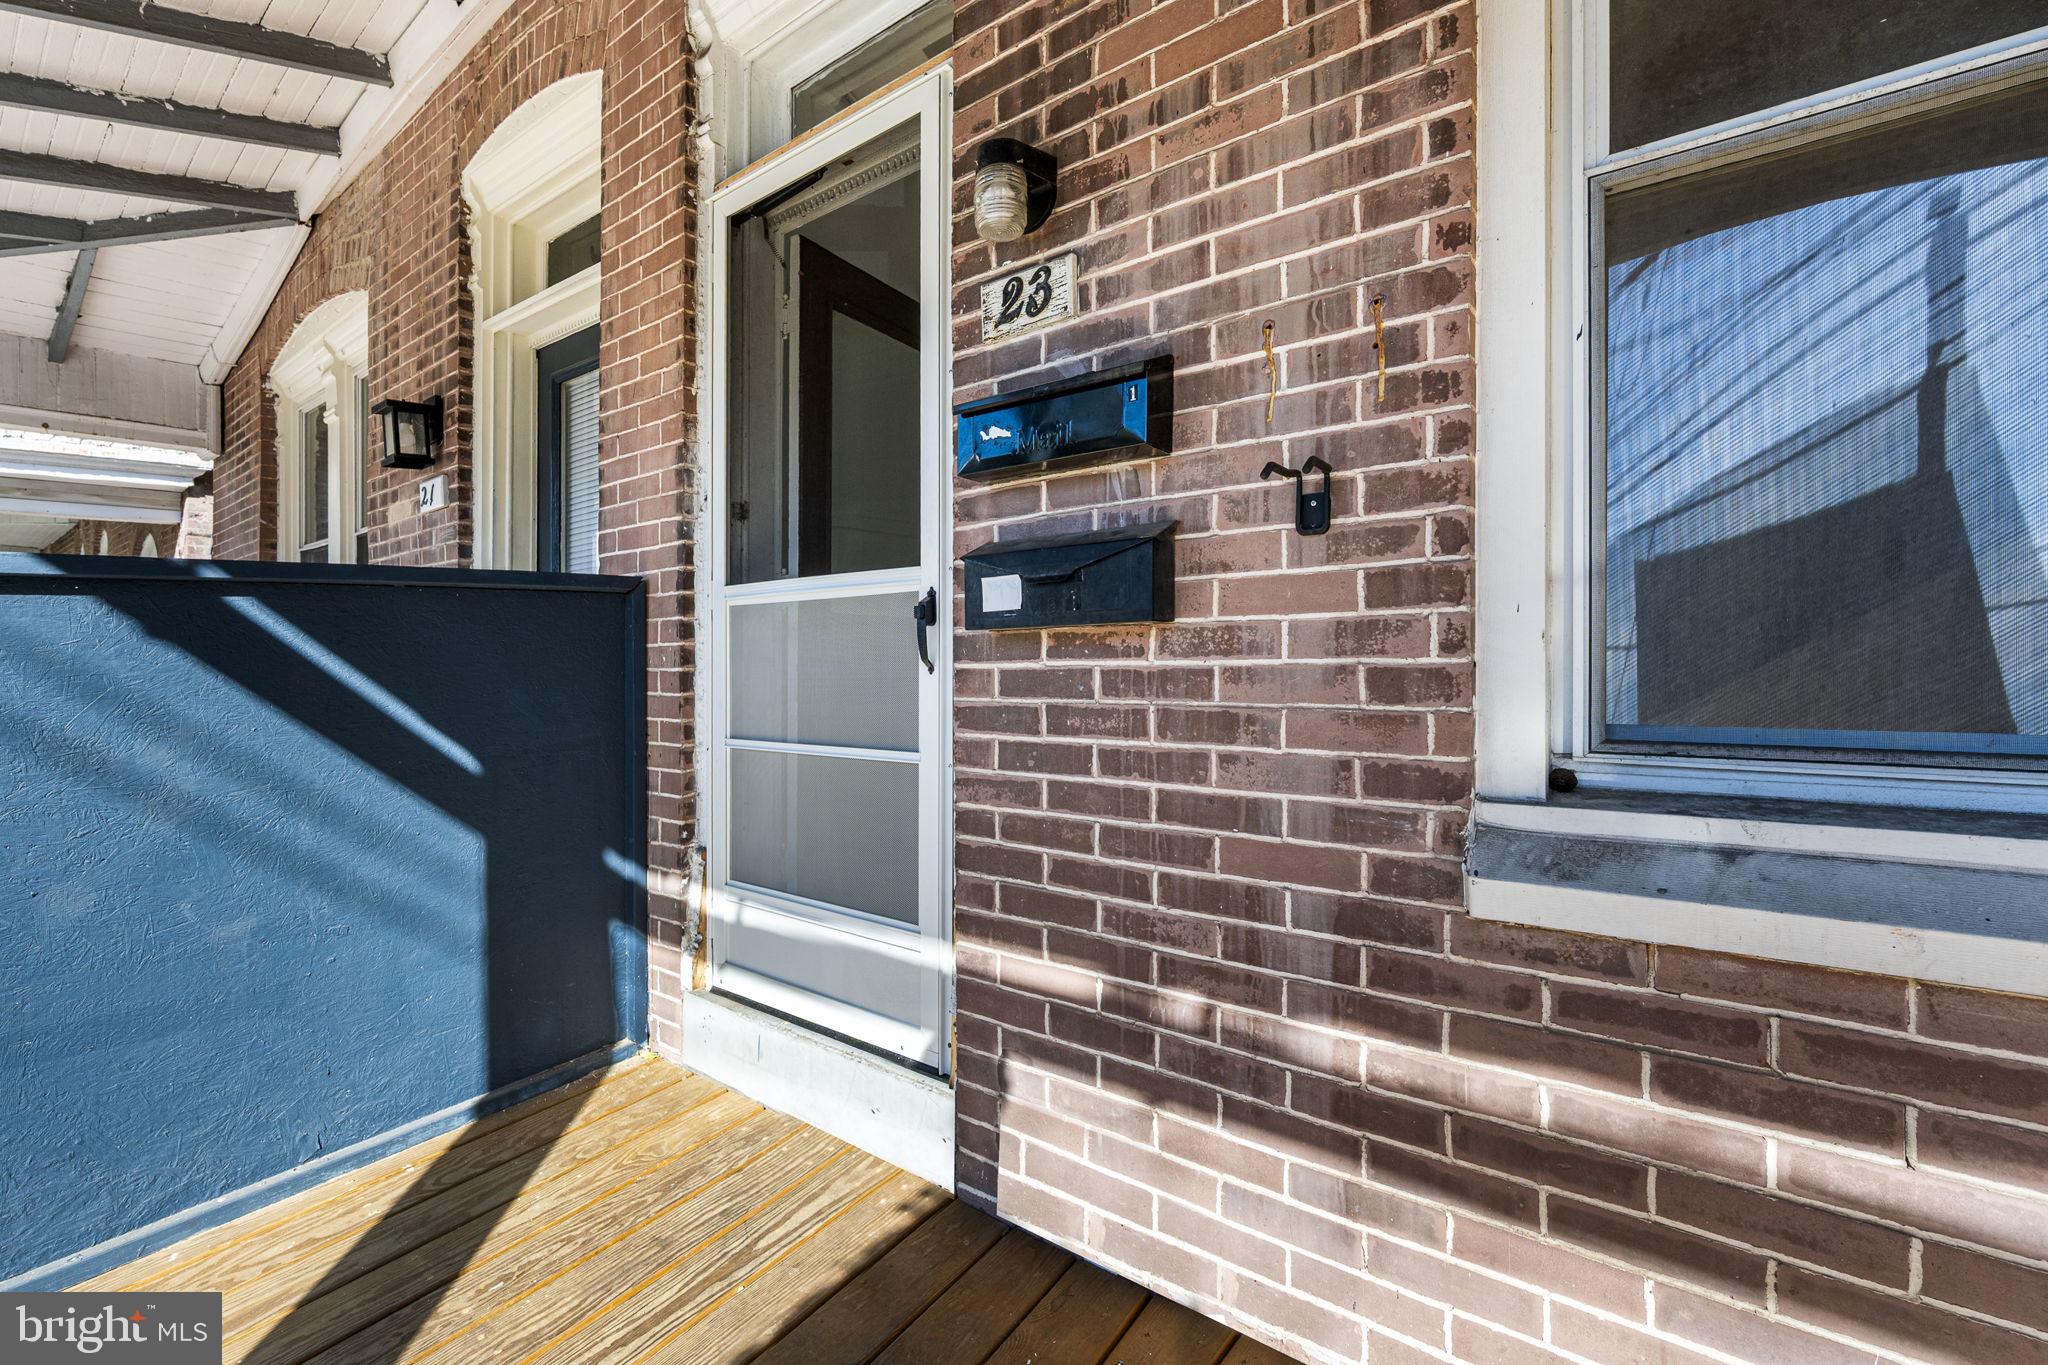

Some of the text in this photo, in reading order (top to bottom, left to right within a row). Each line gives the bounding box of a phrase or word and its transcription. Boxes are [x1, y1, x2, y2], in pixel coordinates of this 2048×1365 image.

[994, 265, 1052, 329] 23
[1128, 385, 1137, 402] 1
[1015, 419, 1073, 455] Mail
[420, 483, 435, 507] 21
